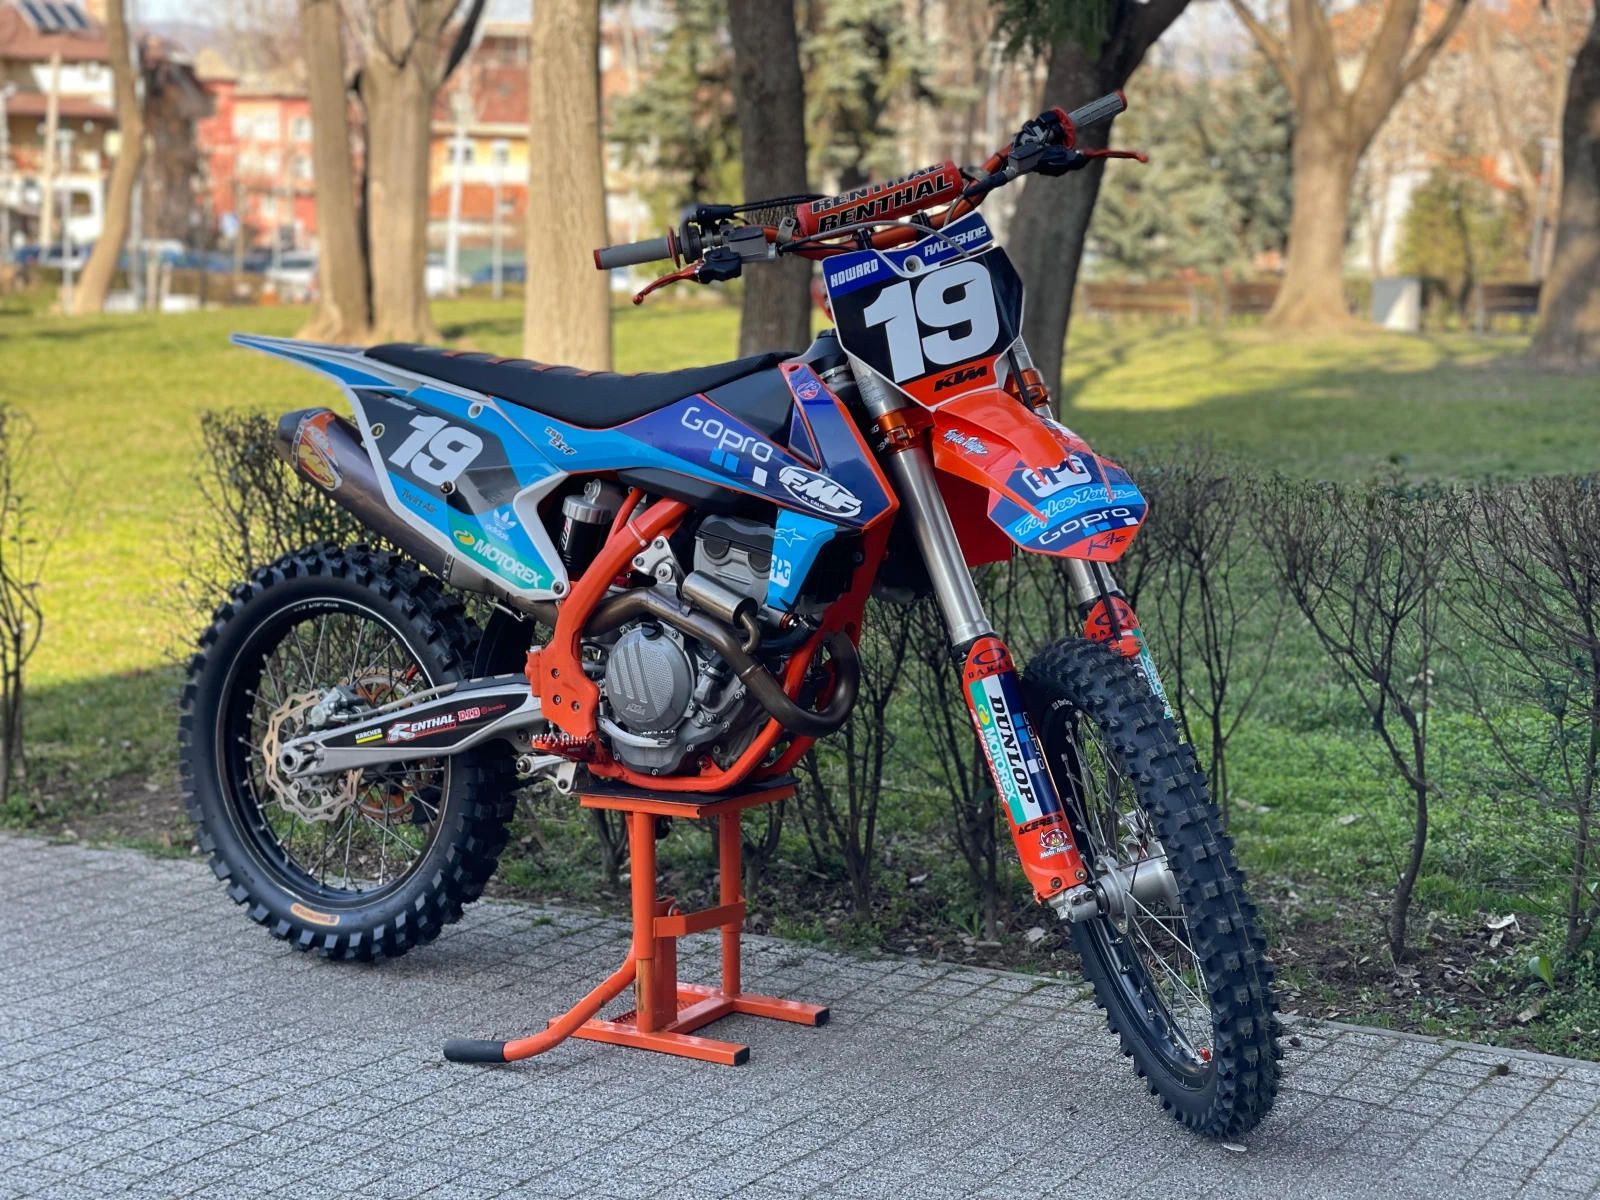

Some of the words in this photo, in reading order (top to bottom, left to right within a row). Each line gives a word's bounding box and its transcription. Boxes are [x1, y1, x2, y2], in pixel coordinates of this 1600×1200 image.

[818, 173, 953, 233] RENTHAL
[830, 258, 879, 288] HOWARD
[864, 261, 1000, 384] 19
[934, 365, 988, 392] KTM
[388, 414, 483, 486] 19
[401, 489, 422, 508] Twin
[421, 500, 437, 514] Air
[779, 467, 862, 511] FMF
[1047, 497, 1078, 518] Lee
[485, 523, 510, 541] adidas
[473, 538, 543, 589] MOTOREX
[387, 714, 456, 741] RENTHAL
[989, 695, 1036, 804] DUNLOP
[984, 726, 1018, 802] MOTOREX
